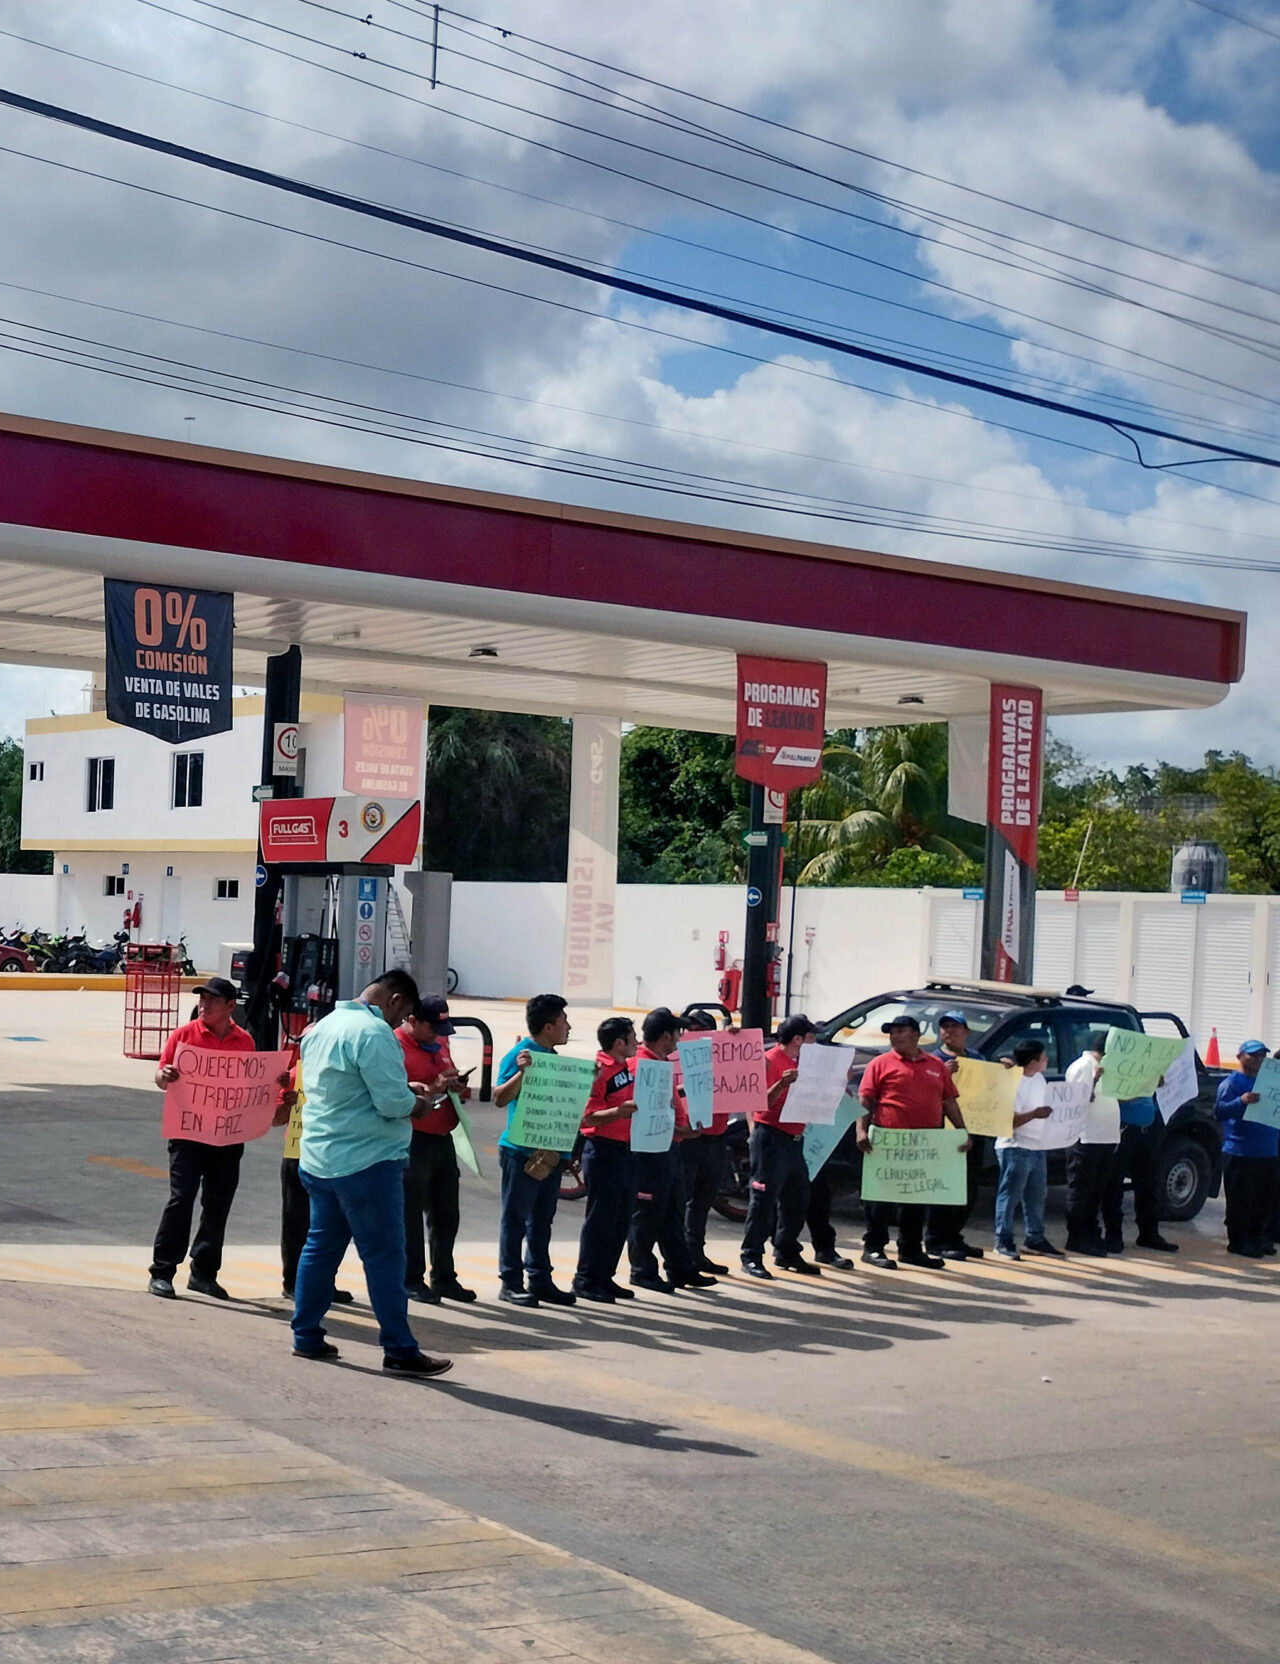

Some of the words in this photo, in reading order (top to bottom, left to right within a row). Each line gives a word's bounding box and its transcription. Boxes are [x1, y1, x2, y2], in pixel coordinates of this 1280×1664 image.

[134, 588, 207, 651] 0%
[136, 650, 208, 675] COMISIÓN
[125, 676, 163, 695] VENTA
[166, 681, 181, 697] DE
[183, 682, 220, 700] VALES
[744, 682, 820, 708] PROGRAMAS
[135, 702, 150, 718] DE
[153, 703, 210, 724] GASOLINA
[747, 707, 763, 727] DE
[765, 710, 815, 731] LEALTAD
[1017, 699, 1033, 790] LEALTAD
[1001, 698, 1017, 825] PROGRAMAS
[1015, 794, 1031, 826] DE
[338, 820, 348, 838] 3
[1114, 1035, 1136, 1054] NO
[1142, 1042, 1152, 1057] A
[177, 1049, 267, 1079] QUEREMOS
[639, 1067, 655, 1088] NO
[186, 1082, 270, 1111] TRABAJAR
[1052, 1086, 1073, 1102] NO
[180, 1111, 202, 1133] EN
[214, 1114, 243, 1136] PAZ
